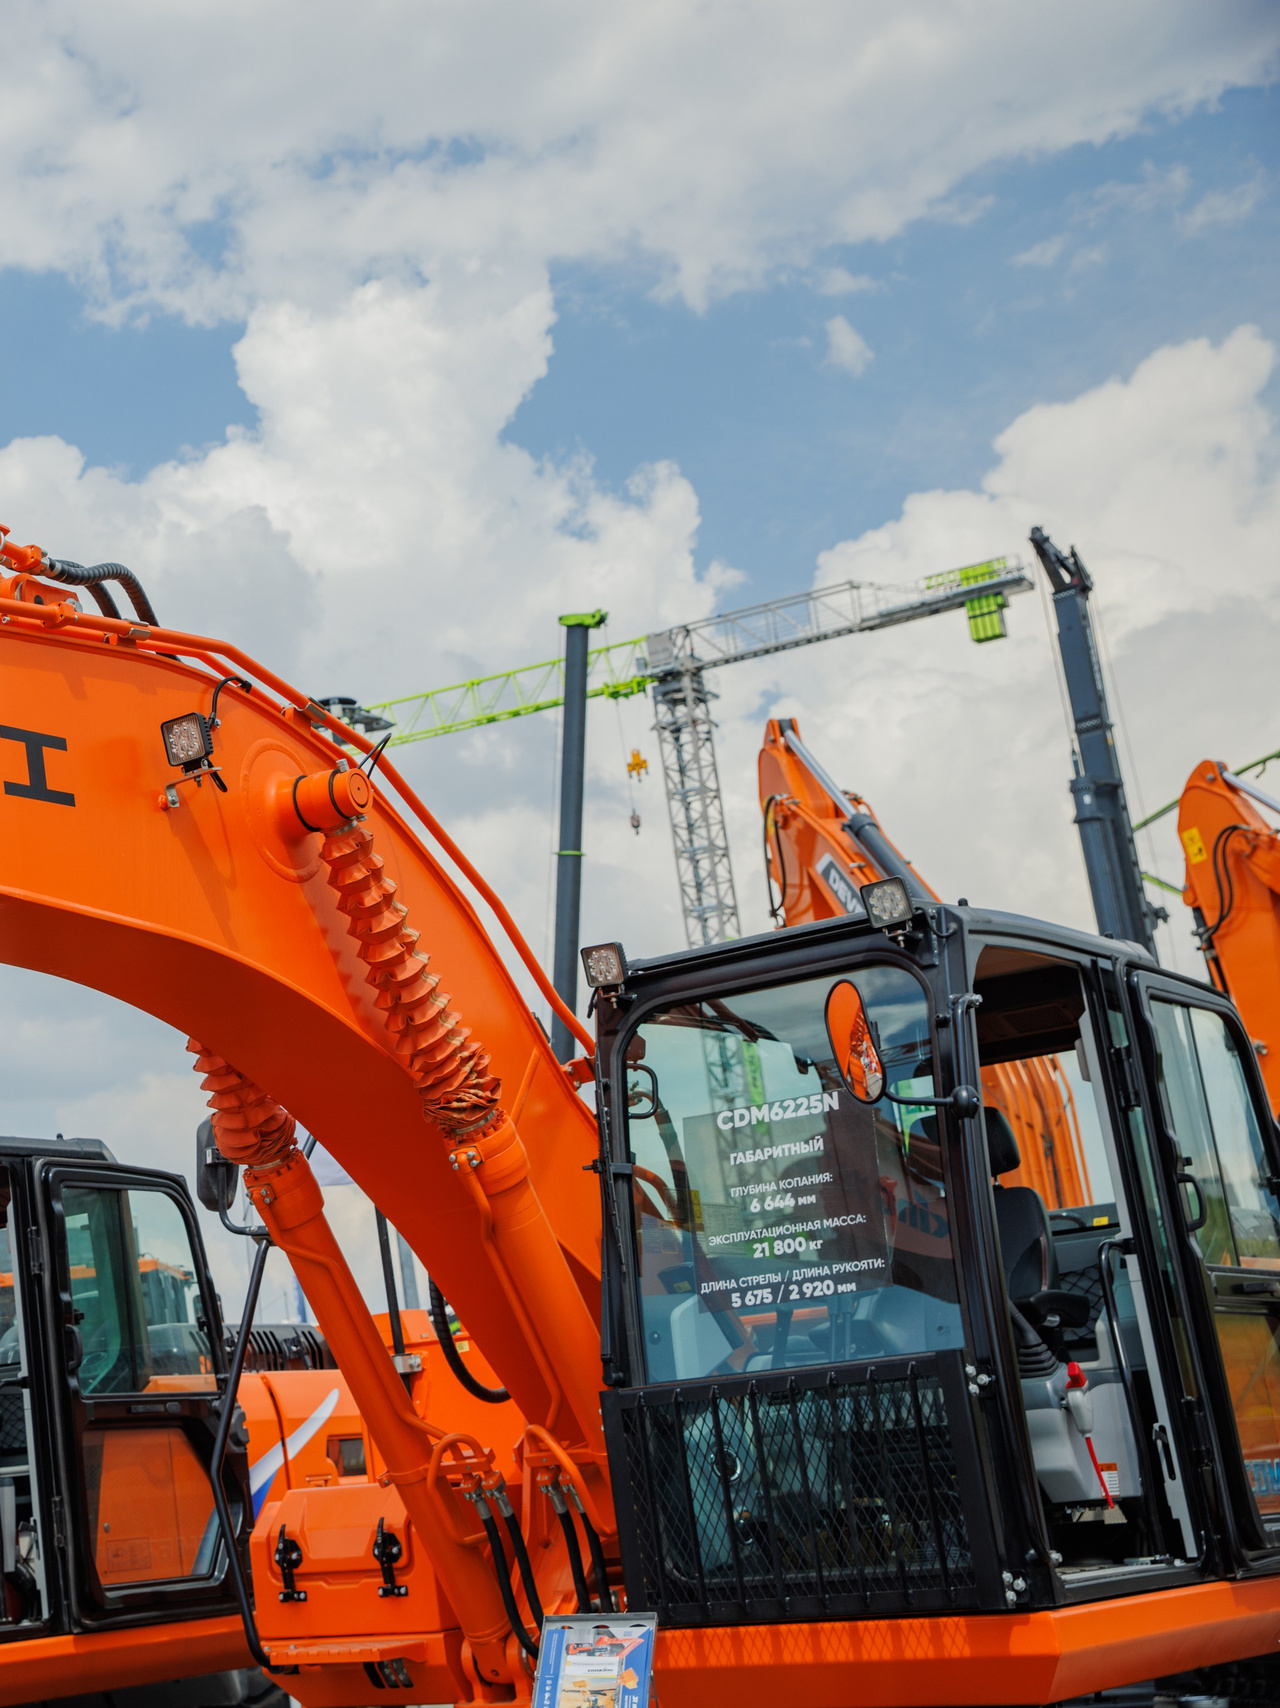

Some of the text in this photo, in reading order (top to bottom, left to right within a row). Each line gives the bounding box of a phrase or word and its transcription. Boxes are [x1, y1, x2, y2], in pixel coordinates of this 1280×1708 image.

[717, 1091, 840, 1131] CDM6225N
[730, 1136, 824, 1166] ГАБАРИТНЫЙ
[730, 1172, 833, 1198] ГЛУБИНА КОПАНИЯ:
[750, 1199, 761, 1213] 6
[764, 1192, 796, 1210] 644
[708, 1220, 821, 1246] ЭКСПЛУАТАЦИОННАЯ
[823, 1214, 867, 1230] МАССА:
[753, 1236, 823, 1258] 21 800 кг
[700, 1279, 737, 1295] ДЛИНА
[739, 1272, 782, 1289] СТРЕЛЫ
[792, 1265, 830, 1283] ДЛИНА
[832, 1258, 885, 1277] РУКОЯТИ:
[731, 1293, 741, 1308] 5
[744, 1289, 773, 1306] 675
[789, 1284, 800, 1300] 2
[801, 1280, 835, 1298] 920
